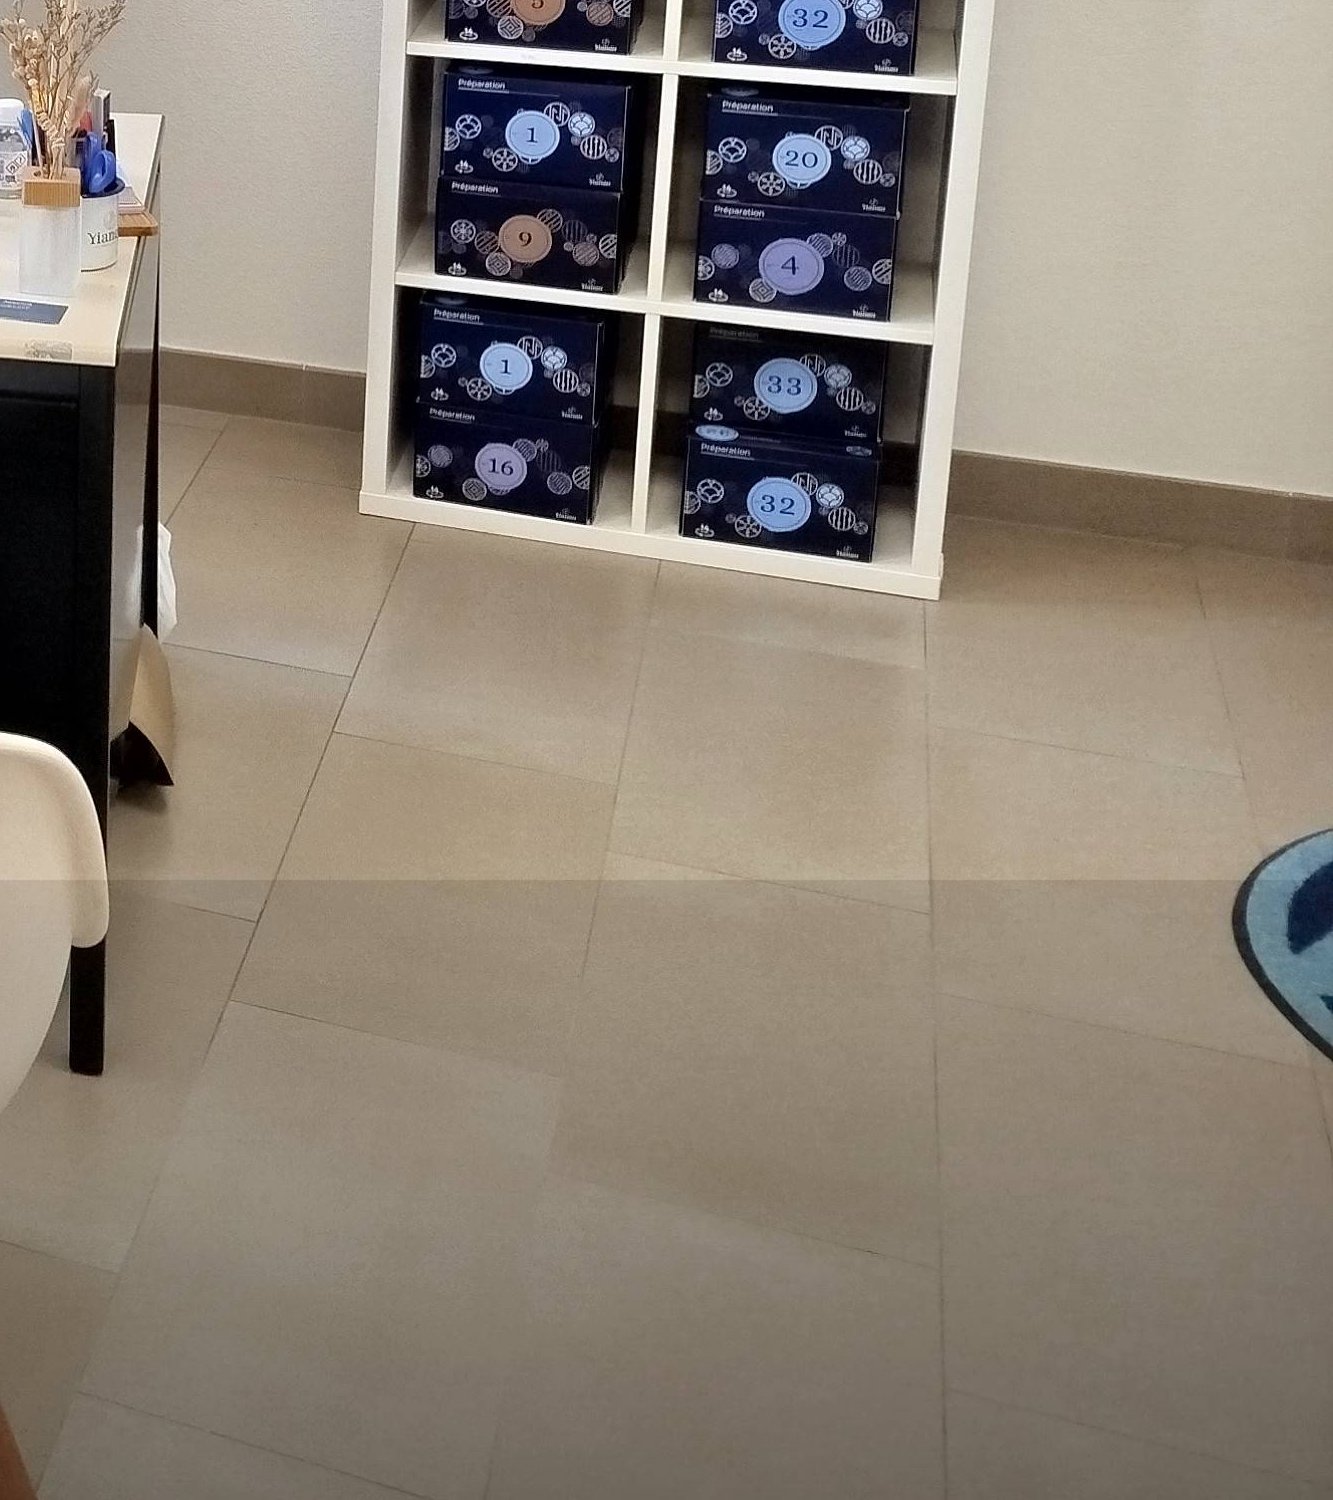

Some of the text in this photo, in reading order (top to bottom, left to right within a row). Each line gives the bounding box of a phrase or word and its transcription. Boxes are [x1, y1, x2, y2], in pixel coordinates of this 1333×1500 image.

[792, 8, 829, 29] 32
[526, 127, 538, 144] 1
[784, 150, 818, 169] 20
[518, 231, 532, 246] 9
[780, 255, 800, 276] 4
[500, 358, 512, 375] 1
[767, 375, 802, 396] 33
[487, 457, 514, 477] 16
[760, 495, 796, 516] 32
